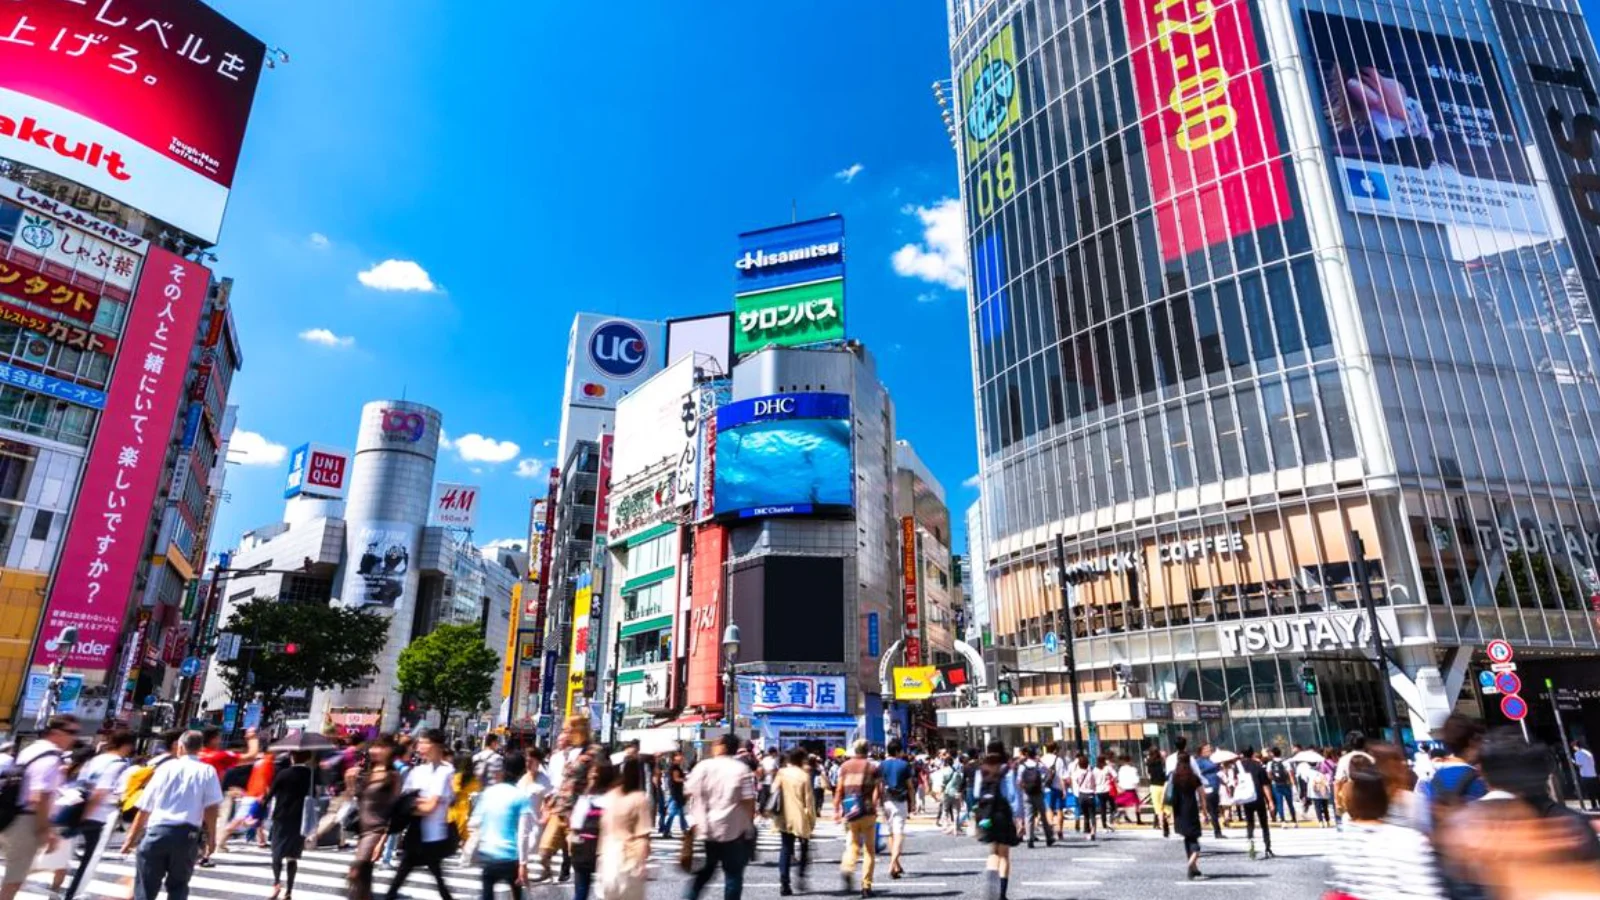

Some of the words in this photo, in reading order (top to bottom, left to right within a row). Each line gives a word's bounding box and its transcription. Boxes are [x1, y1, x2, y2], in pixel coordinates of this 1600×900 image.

[16, 186, 142, 247] しゃぶしゃぶバイキング
[59, 233, 135, 277] しゃぶ葉
[735, 241, 839, 270] Hisamitsu
[739, 297, 837, 333] サロンパス
[48, 321, 104, 351] ガスト
[754, 397, 795, 416] DHC
[677, 393, 698, 498] もんじゃ
[312, 470, 339, 484] QLO
[314, 456, 340, 471] UNI
[438, 489, 476, 511] H&M
[768, 506, 795, 514] Channel
[1160, 531, 1244, 563] COFFEE
[1223, 613, 1391, 651] TSUTAYA
[752, 680, 837, 706] 堂書店
